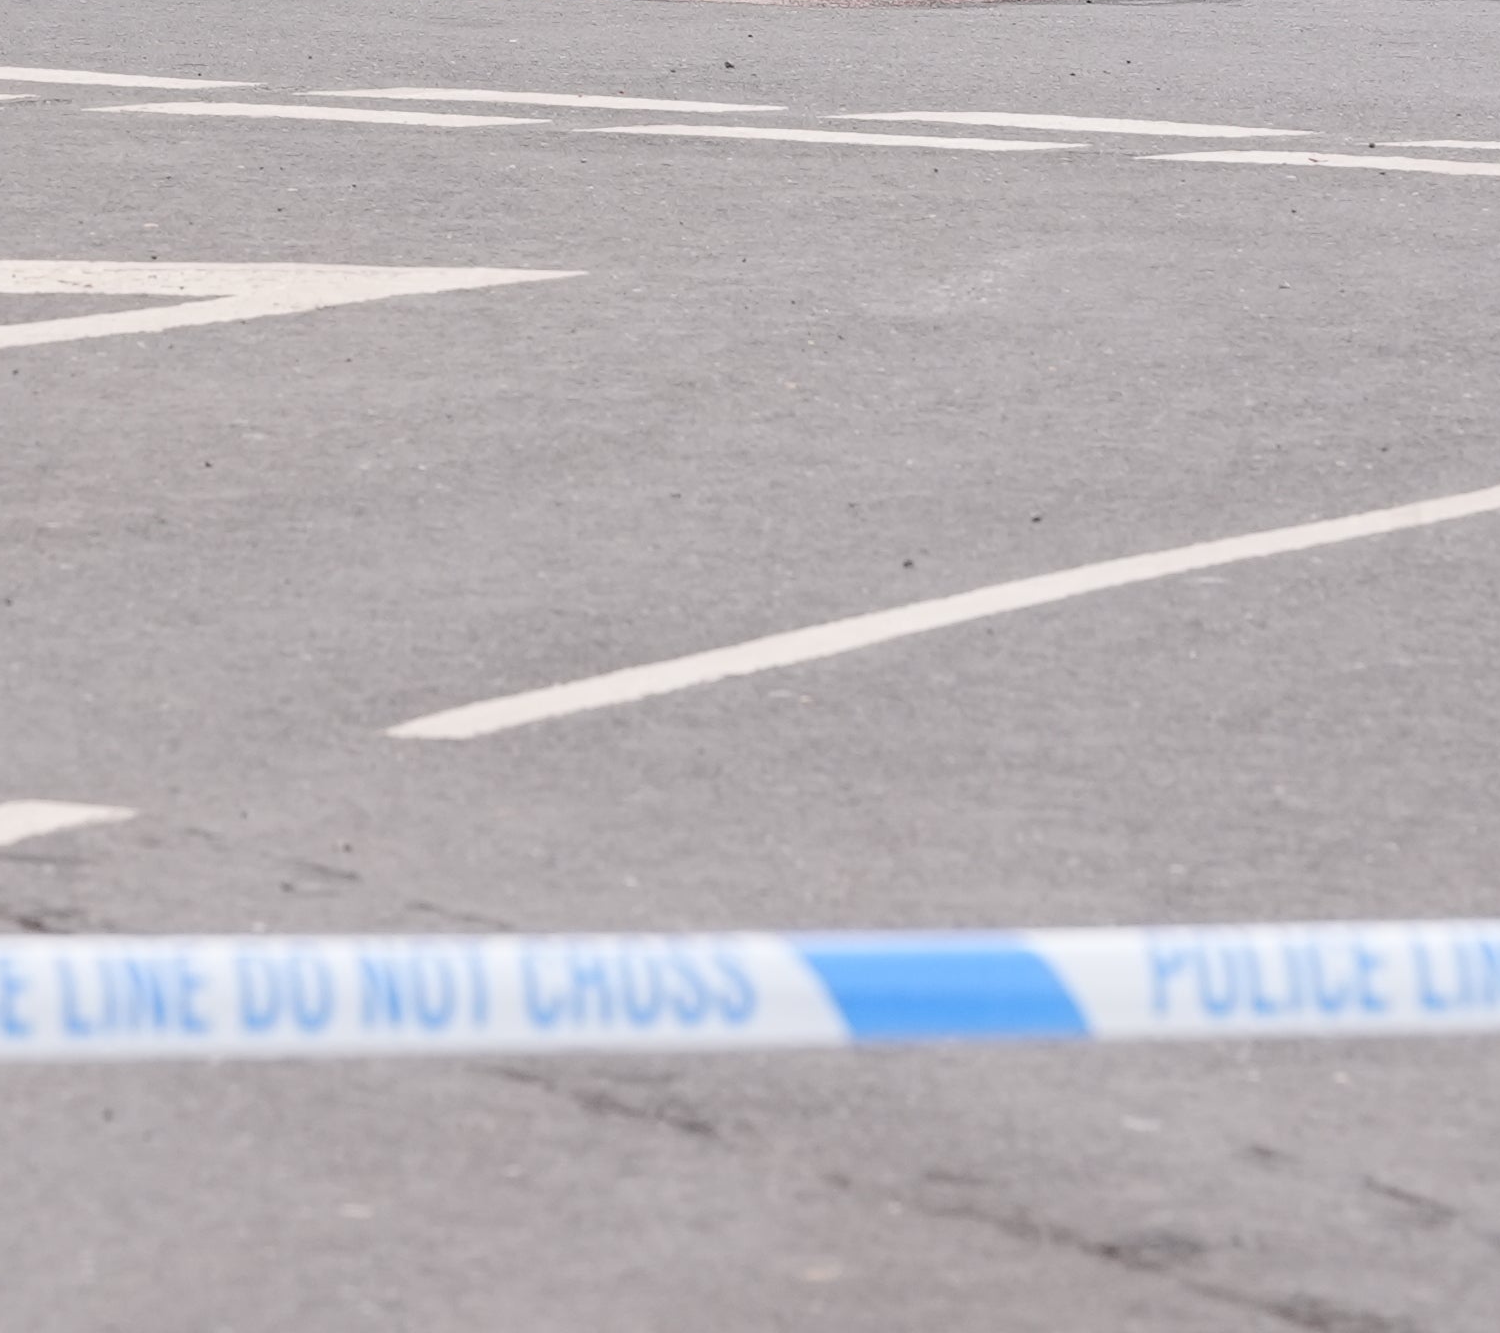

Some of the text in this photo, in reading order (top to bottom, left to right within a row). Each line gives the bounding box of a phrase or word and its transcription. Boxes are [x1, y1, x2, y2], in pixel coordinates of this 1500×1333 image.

[60, 950, 210, 1038] LINE
[238, 948, 335, 1035] DO
[361, 945, 488, 1030] NOT
[520, 943, 757, 1028] CROSS
[1149, 933, 1387, 1016] POLICE
